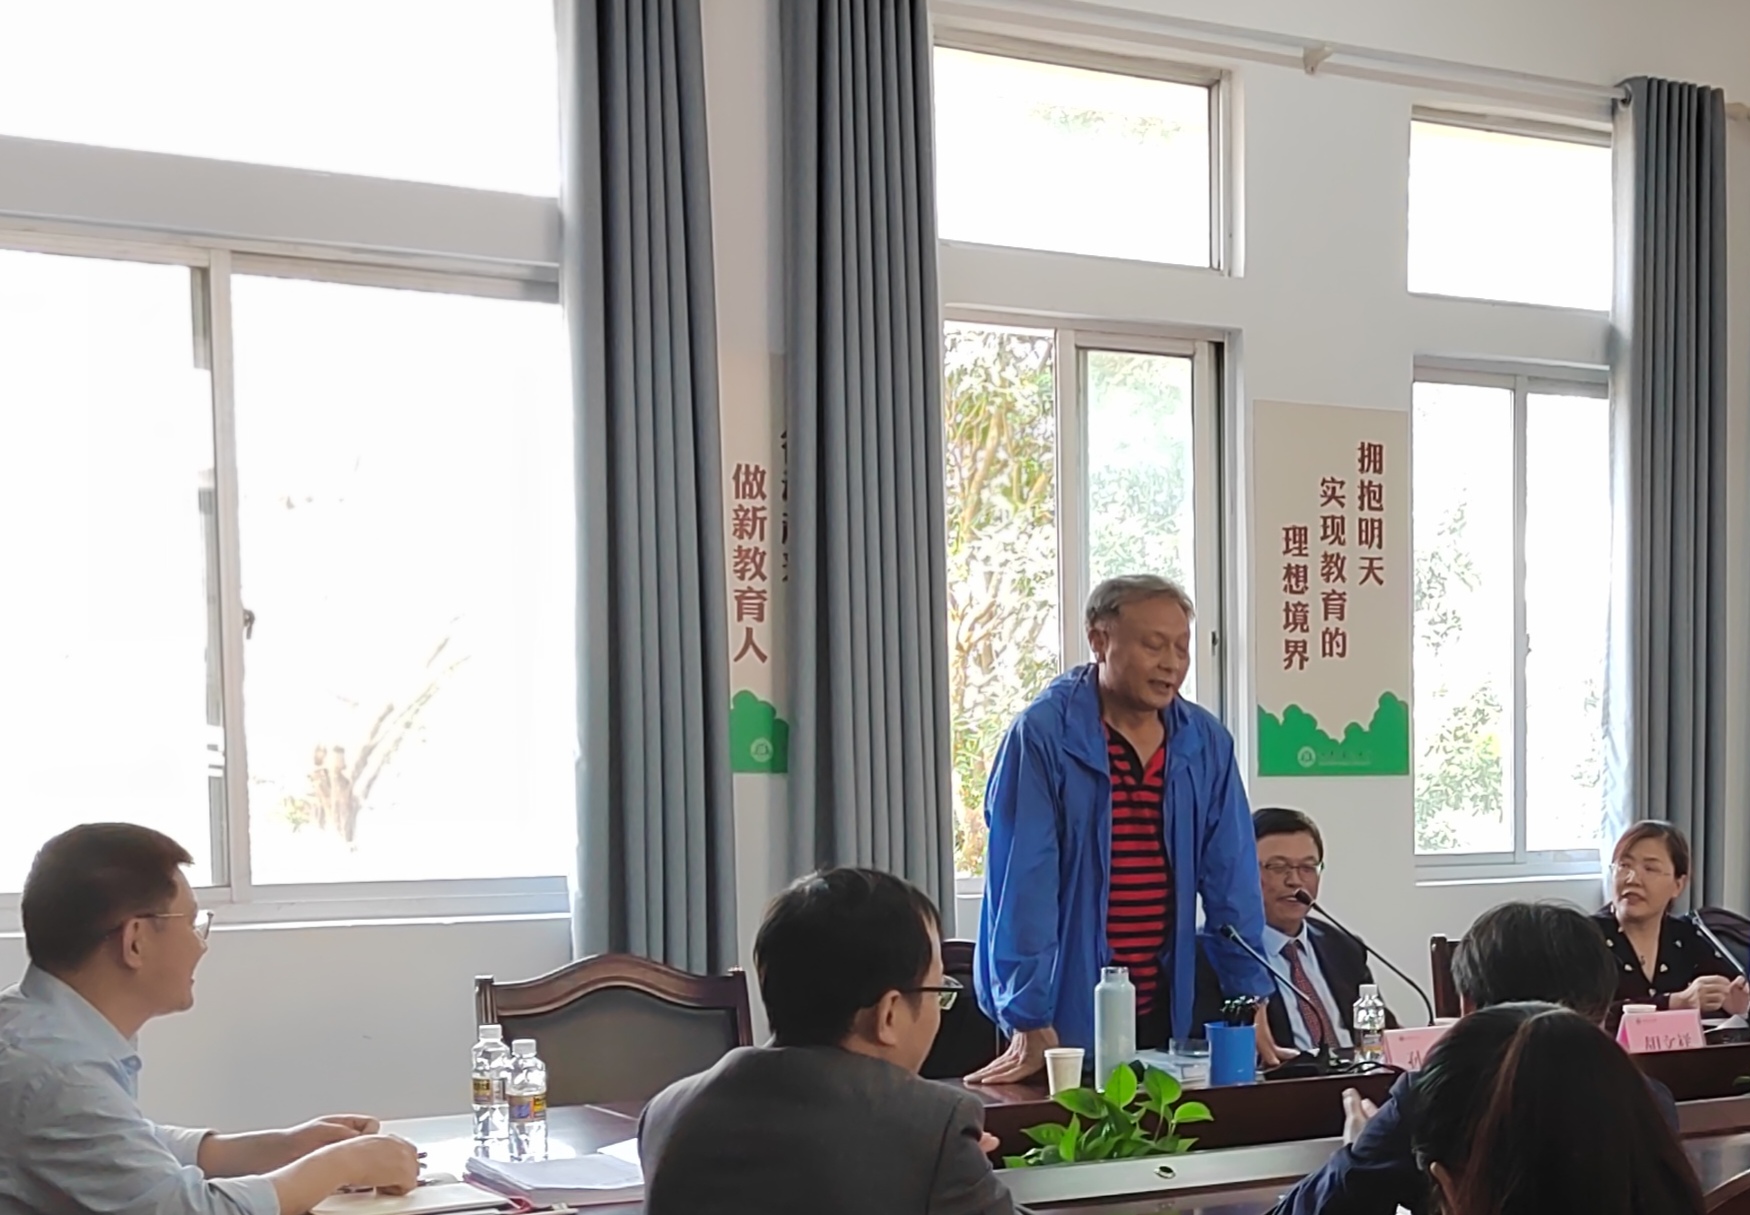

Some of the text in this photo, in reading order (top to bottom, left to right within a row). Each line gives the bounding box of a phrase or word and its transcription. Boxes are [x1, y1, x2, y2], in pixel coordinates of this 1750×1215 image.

[732, 462, 768, 664] 做新教育人
[1319, 476, 1347, 659] 实现教育的
[1357, 441, 1384, 587] 拥抱明天
[1282, 524, 1310, 671] 理想境界
